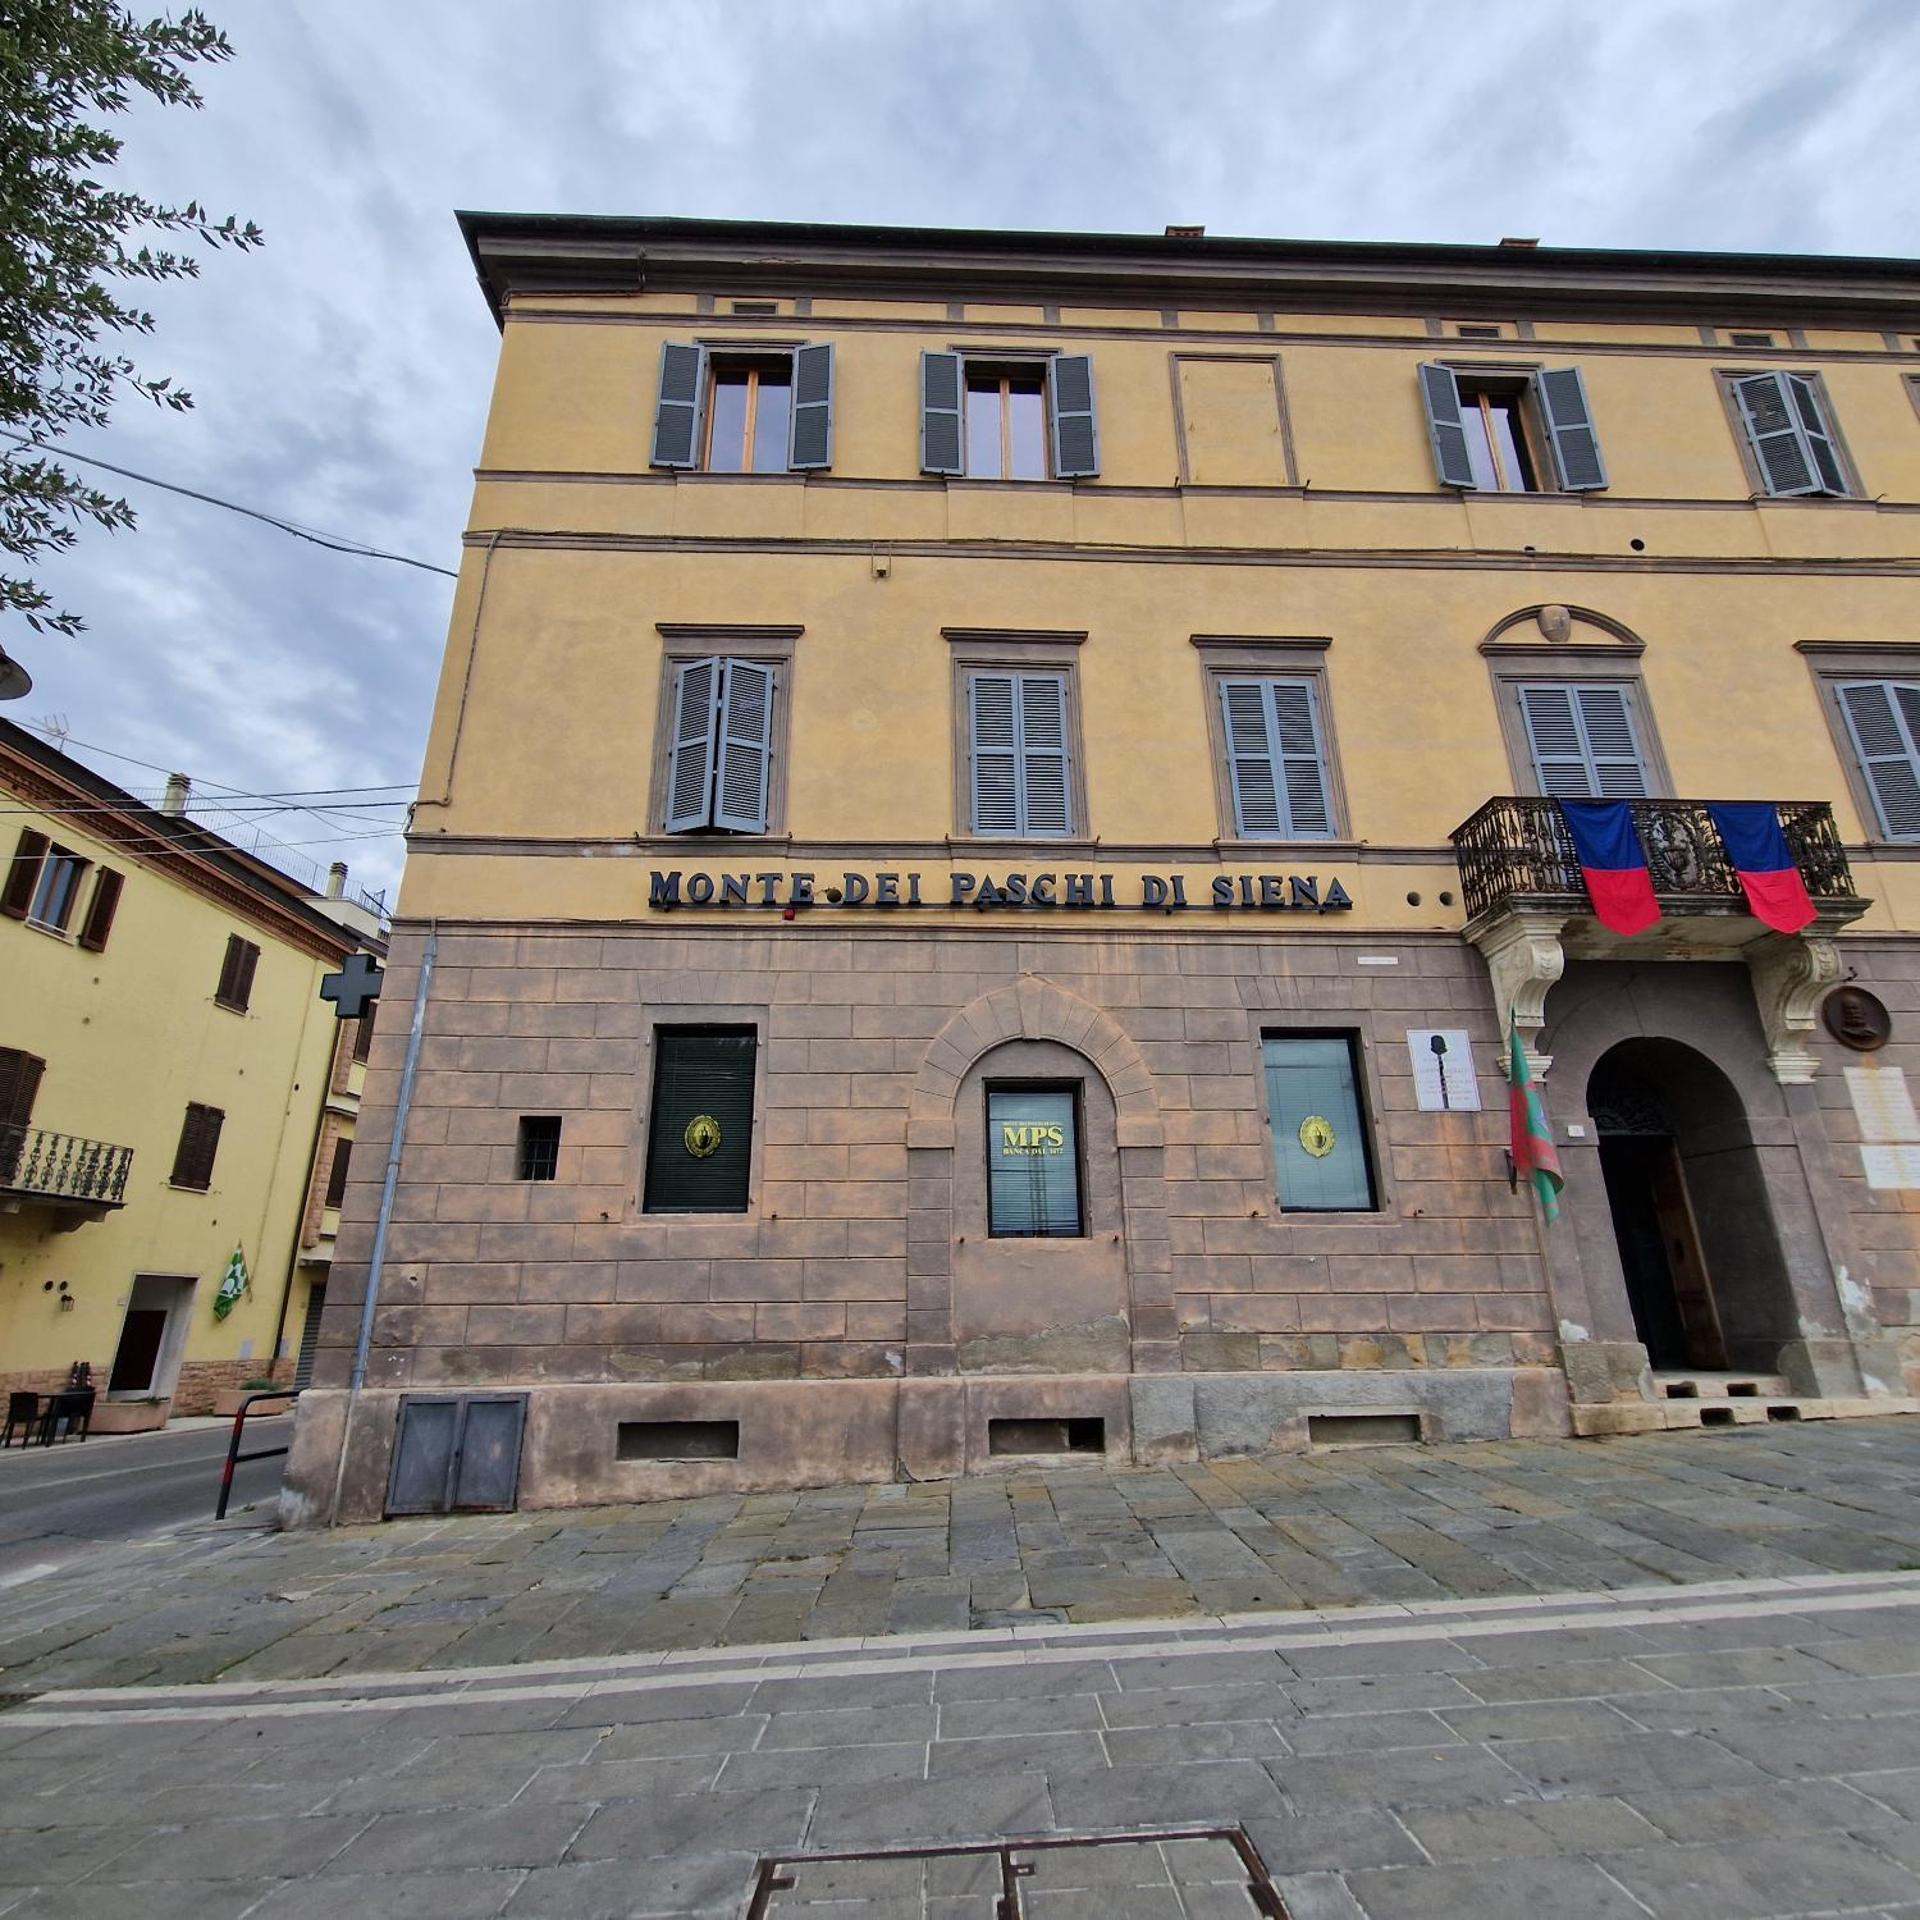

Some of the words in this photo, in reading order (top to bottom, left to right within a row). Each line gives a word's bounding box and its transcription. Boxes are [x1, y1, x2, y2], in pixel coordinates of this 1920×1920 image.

[649, 871, 815, 905] MONTE
[843, 873, 921, 905] DEI
[950, 873, 1115, 906] PASCHI
[1141, 875, 1187, 906] DI
[1212, 875, 1353, 907] SIENA
[1003, 1126, 1064, 1147] MPS
